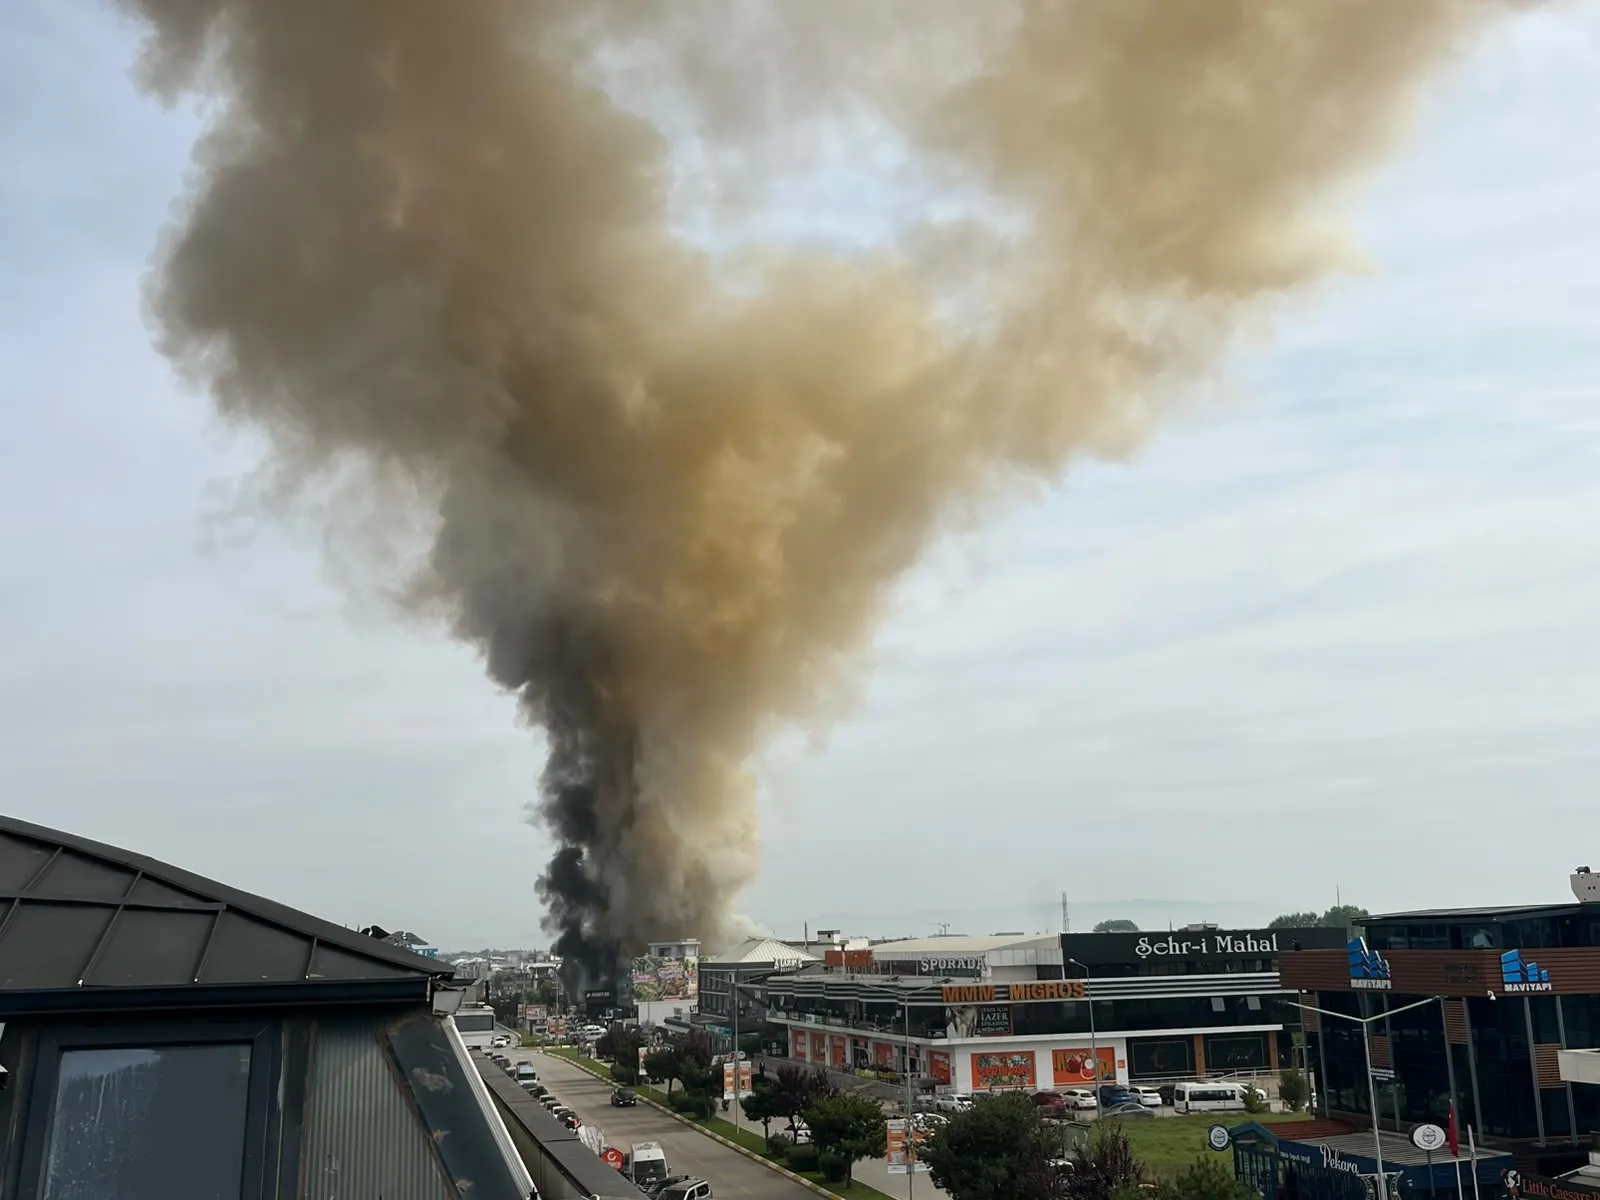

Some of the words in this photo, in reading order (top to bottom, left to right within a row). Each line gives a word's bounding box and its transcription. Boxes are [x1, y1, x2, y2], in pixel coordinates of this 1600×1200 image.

[1135, 935, 1208, 959] Şehr-i
[1214, 932, 1279, 953] Mahal
[921, 955, 987, 972] SPORADA
[943, 985, 996, 1003] MMM
[981, 1012, 1009, 1021] LAZER
[1319, 1143, 1360, 1174] Pekara
[1522, 1178, 1549, 1197] Little
